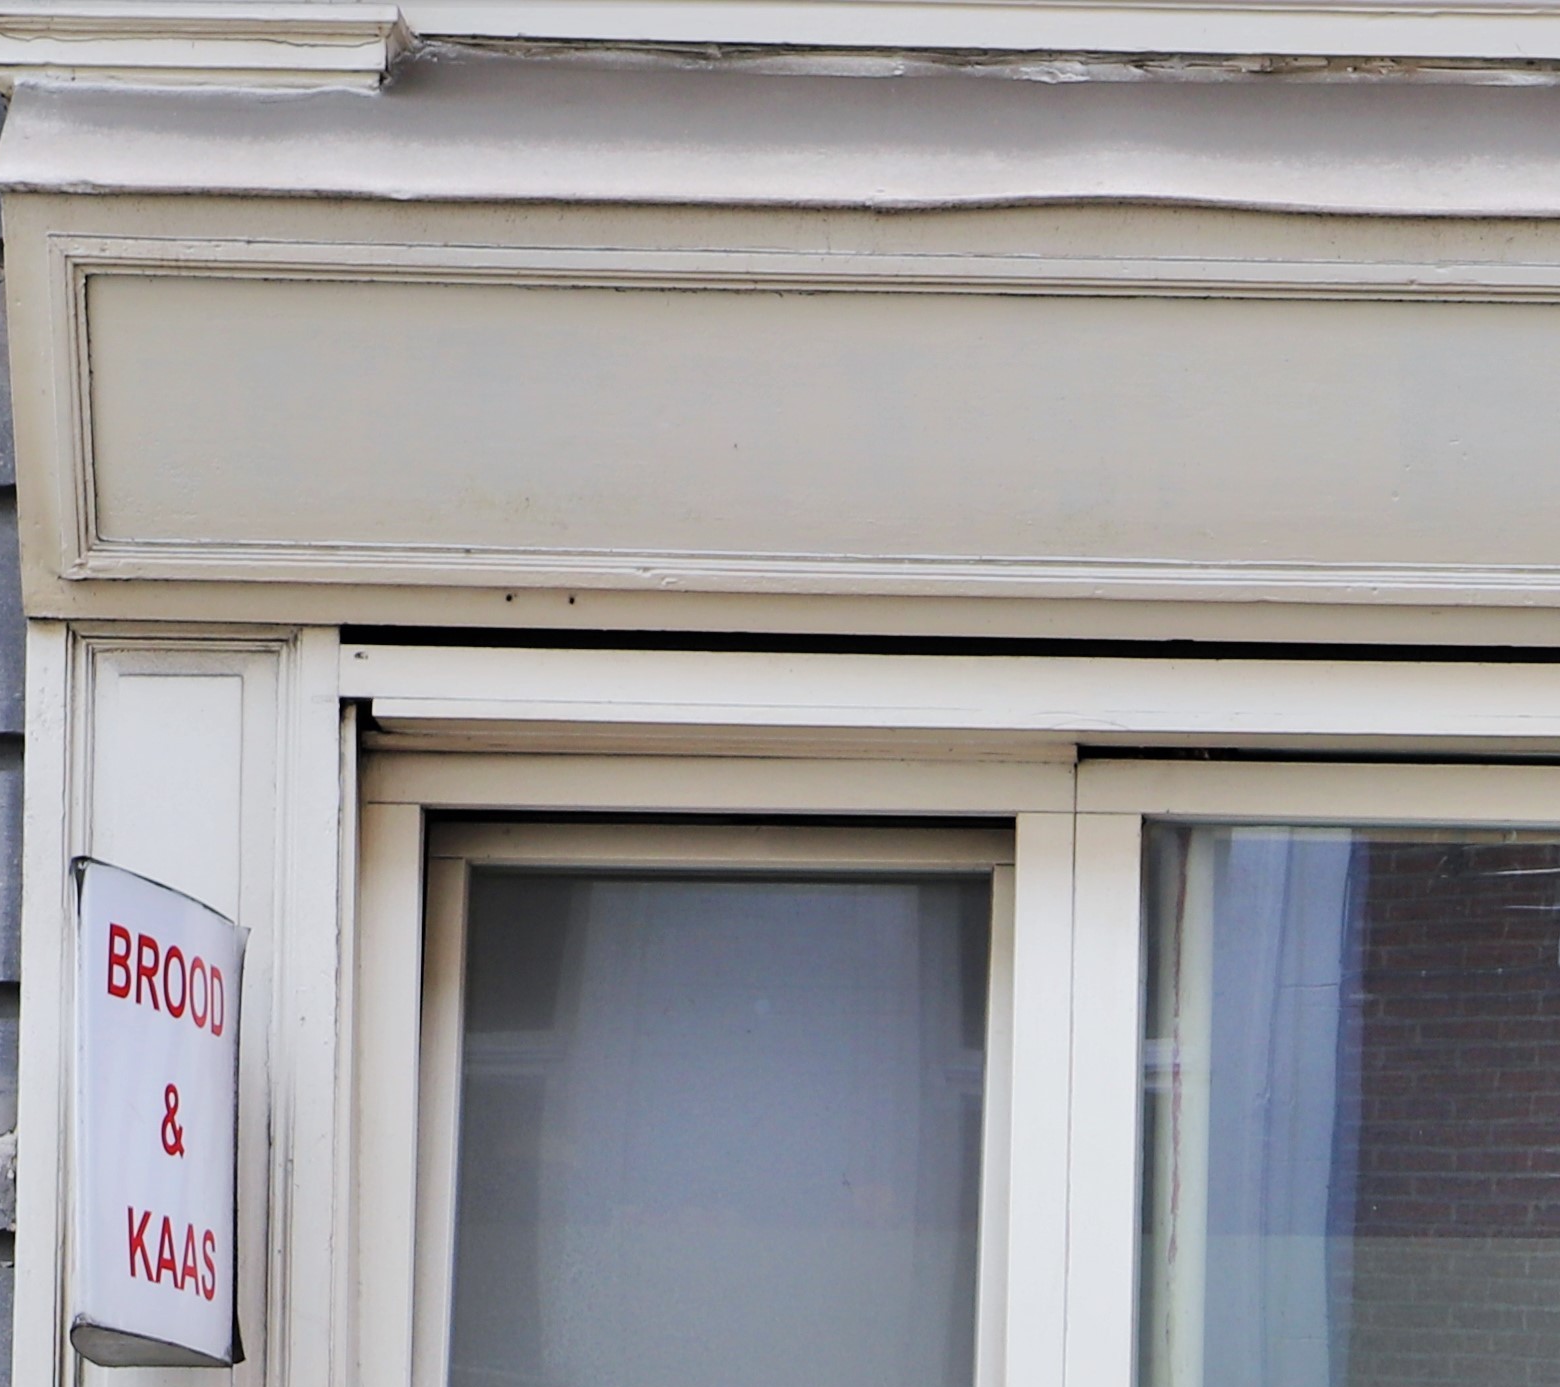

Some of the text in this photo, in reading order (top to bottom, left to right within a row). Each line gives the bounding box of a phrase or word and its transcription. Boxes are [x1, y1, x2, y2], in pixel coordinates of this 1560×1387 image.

[107, 923, 224, 1037] BROOD
[161, 1082, 185, 1159] &
[127, 1205, 216, 1302] KAAS
